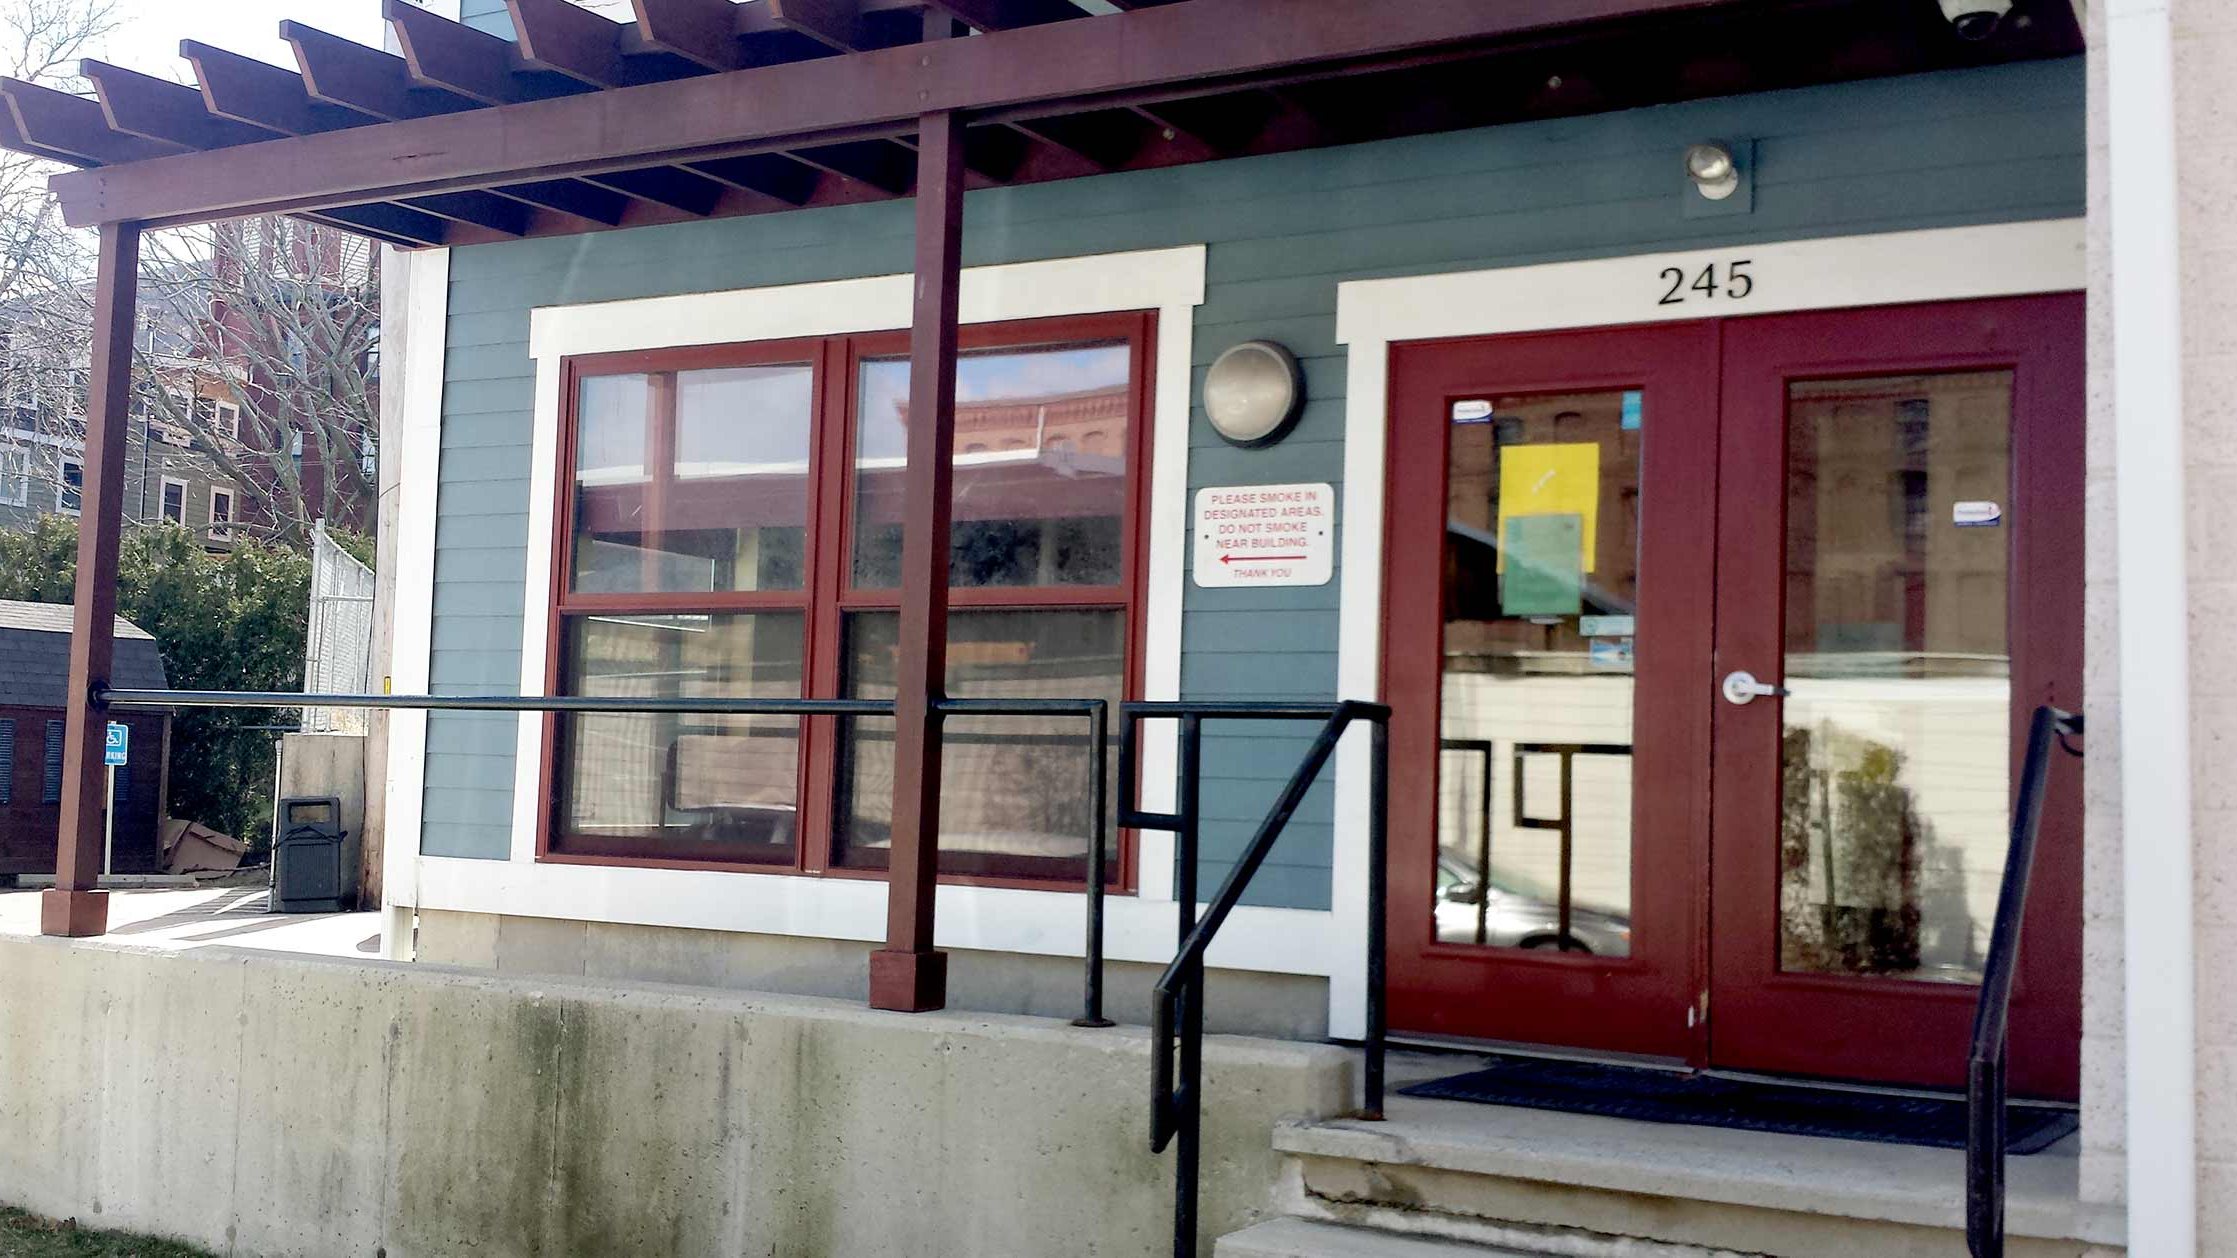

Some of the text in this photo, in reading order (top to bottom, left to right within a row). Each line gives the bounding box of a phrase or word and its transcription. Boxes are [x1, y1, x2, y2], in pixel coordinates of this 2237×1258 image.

[1659, 260, 1752, 305] 245
[1211, 491, 1317, 504] PLEASE SMOKE IN
[1204, 506, 1324, 520] DESIGNATED AREAS.
[1218, 522, 1308, 534] DO NOT SMOKE
[1216, 537, 1309, 549] NEAR BUILDING.
[1233, 568, 1292, 578] THANK YOU
